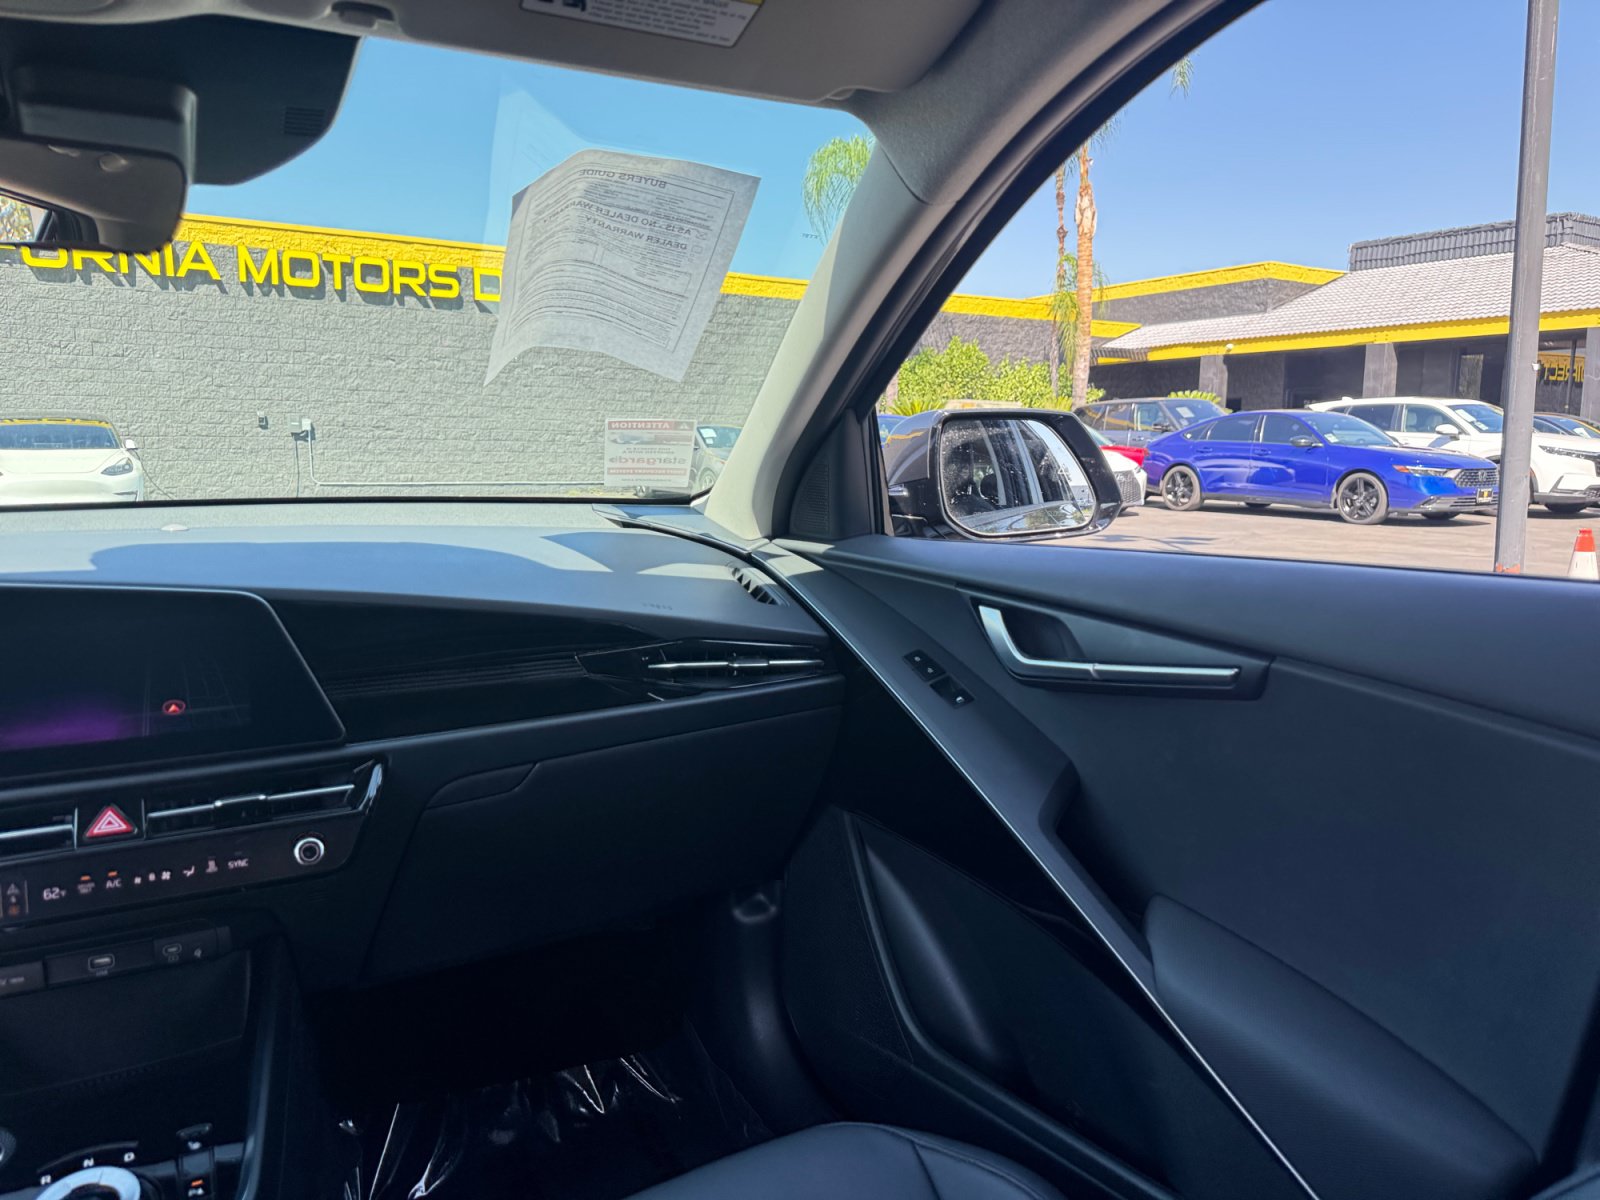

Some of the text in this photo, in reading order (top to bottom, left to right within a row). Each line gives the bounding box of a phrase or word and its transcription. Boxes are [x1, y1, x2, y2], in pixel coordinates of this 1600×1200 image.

[0, 239, 222, 281] ORNIA
[237, 243, 462, 299] MOTORS
[105, 878, 122, 889] A/C
[83, 1157, 95, 1167] N
